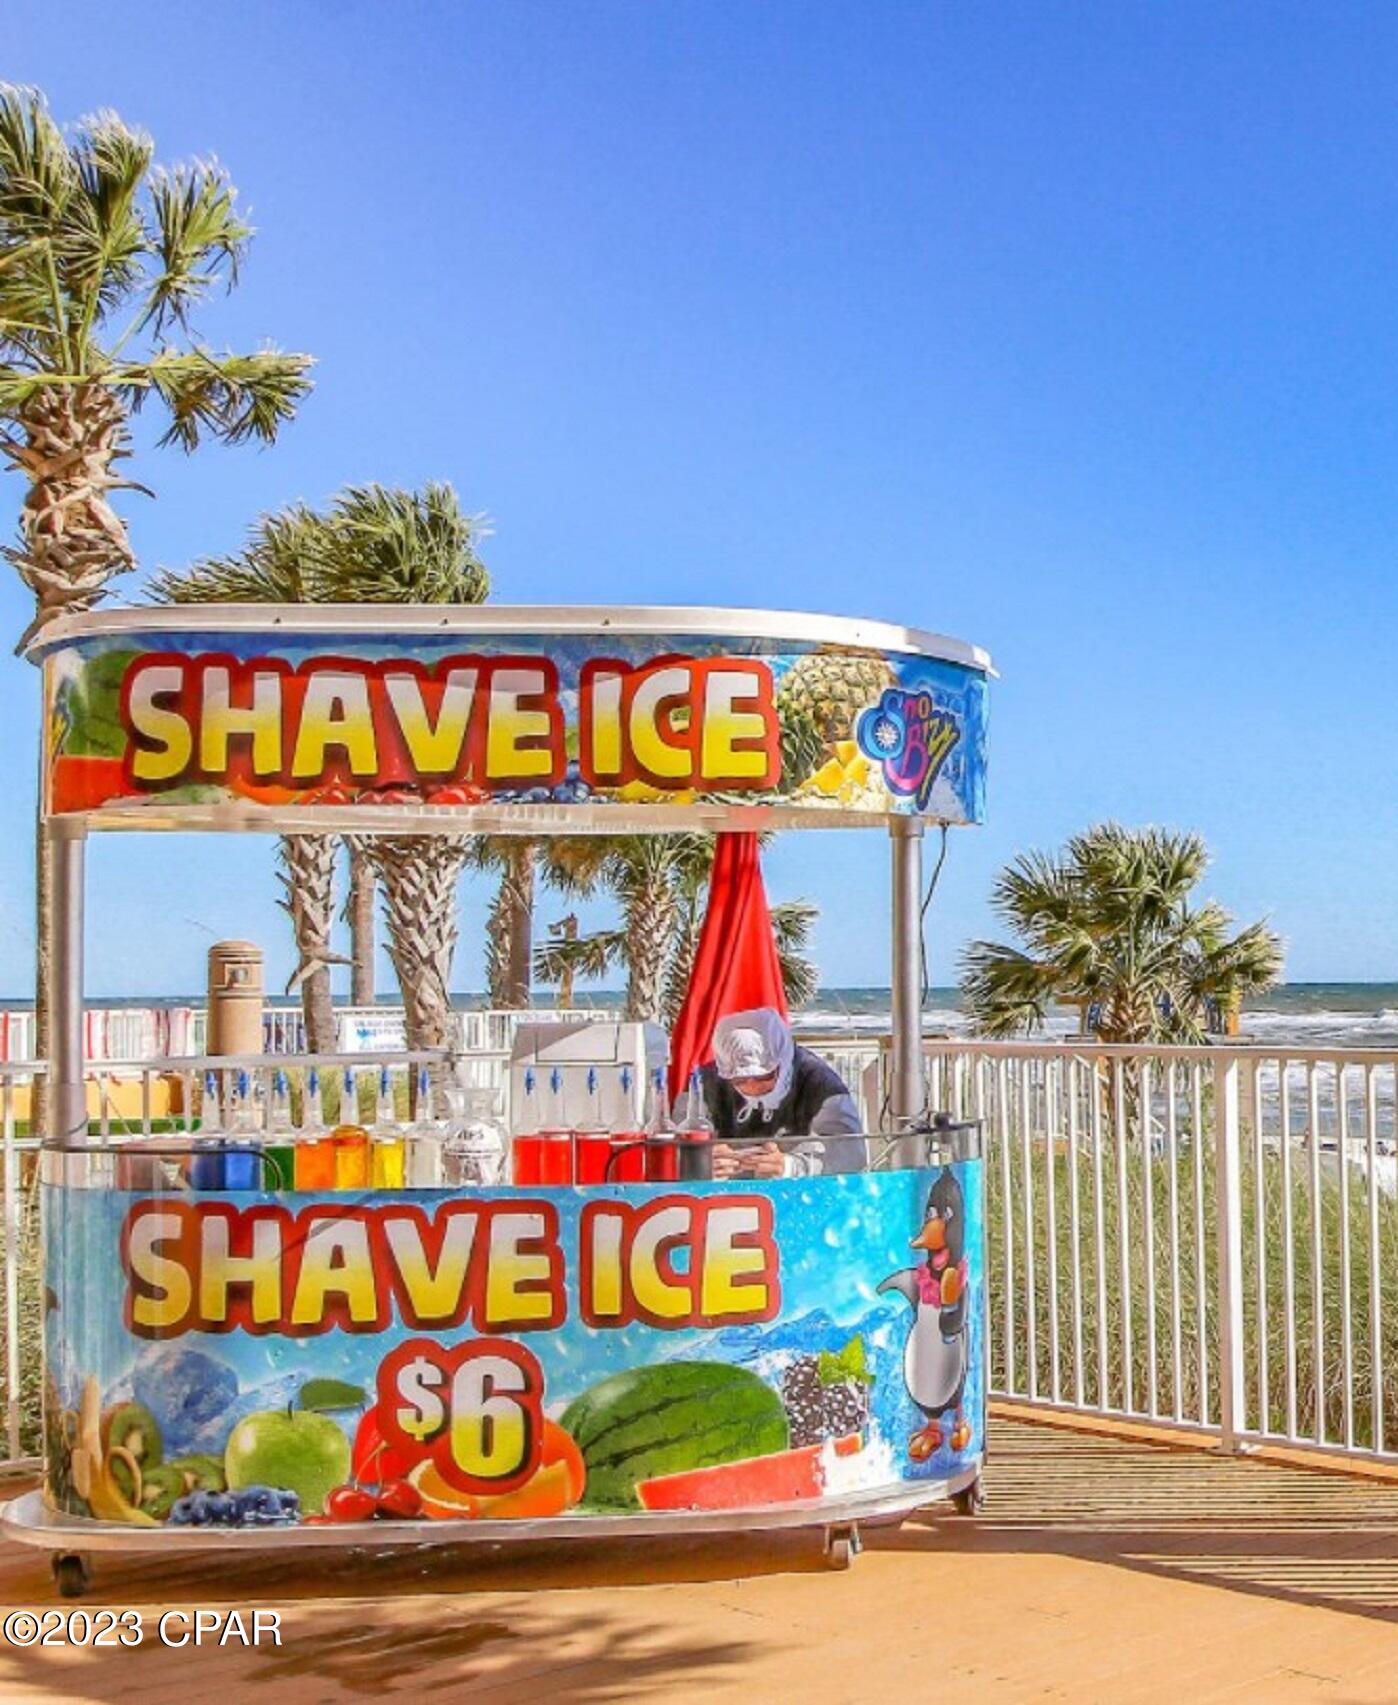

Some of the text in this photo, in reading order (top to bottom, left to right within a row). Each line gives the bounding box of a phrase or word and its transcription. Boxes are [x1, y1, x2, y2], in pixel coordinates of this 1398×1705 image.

[128, 664, 768, 780] SHAVE ICE
[128, 1206, 769, 1328] SHAVE ICE
[396, 1354, 526, 1478] $6
